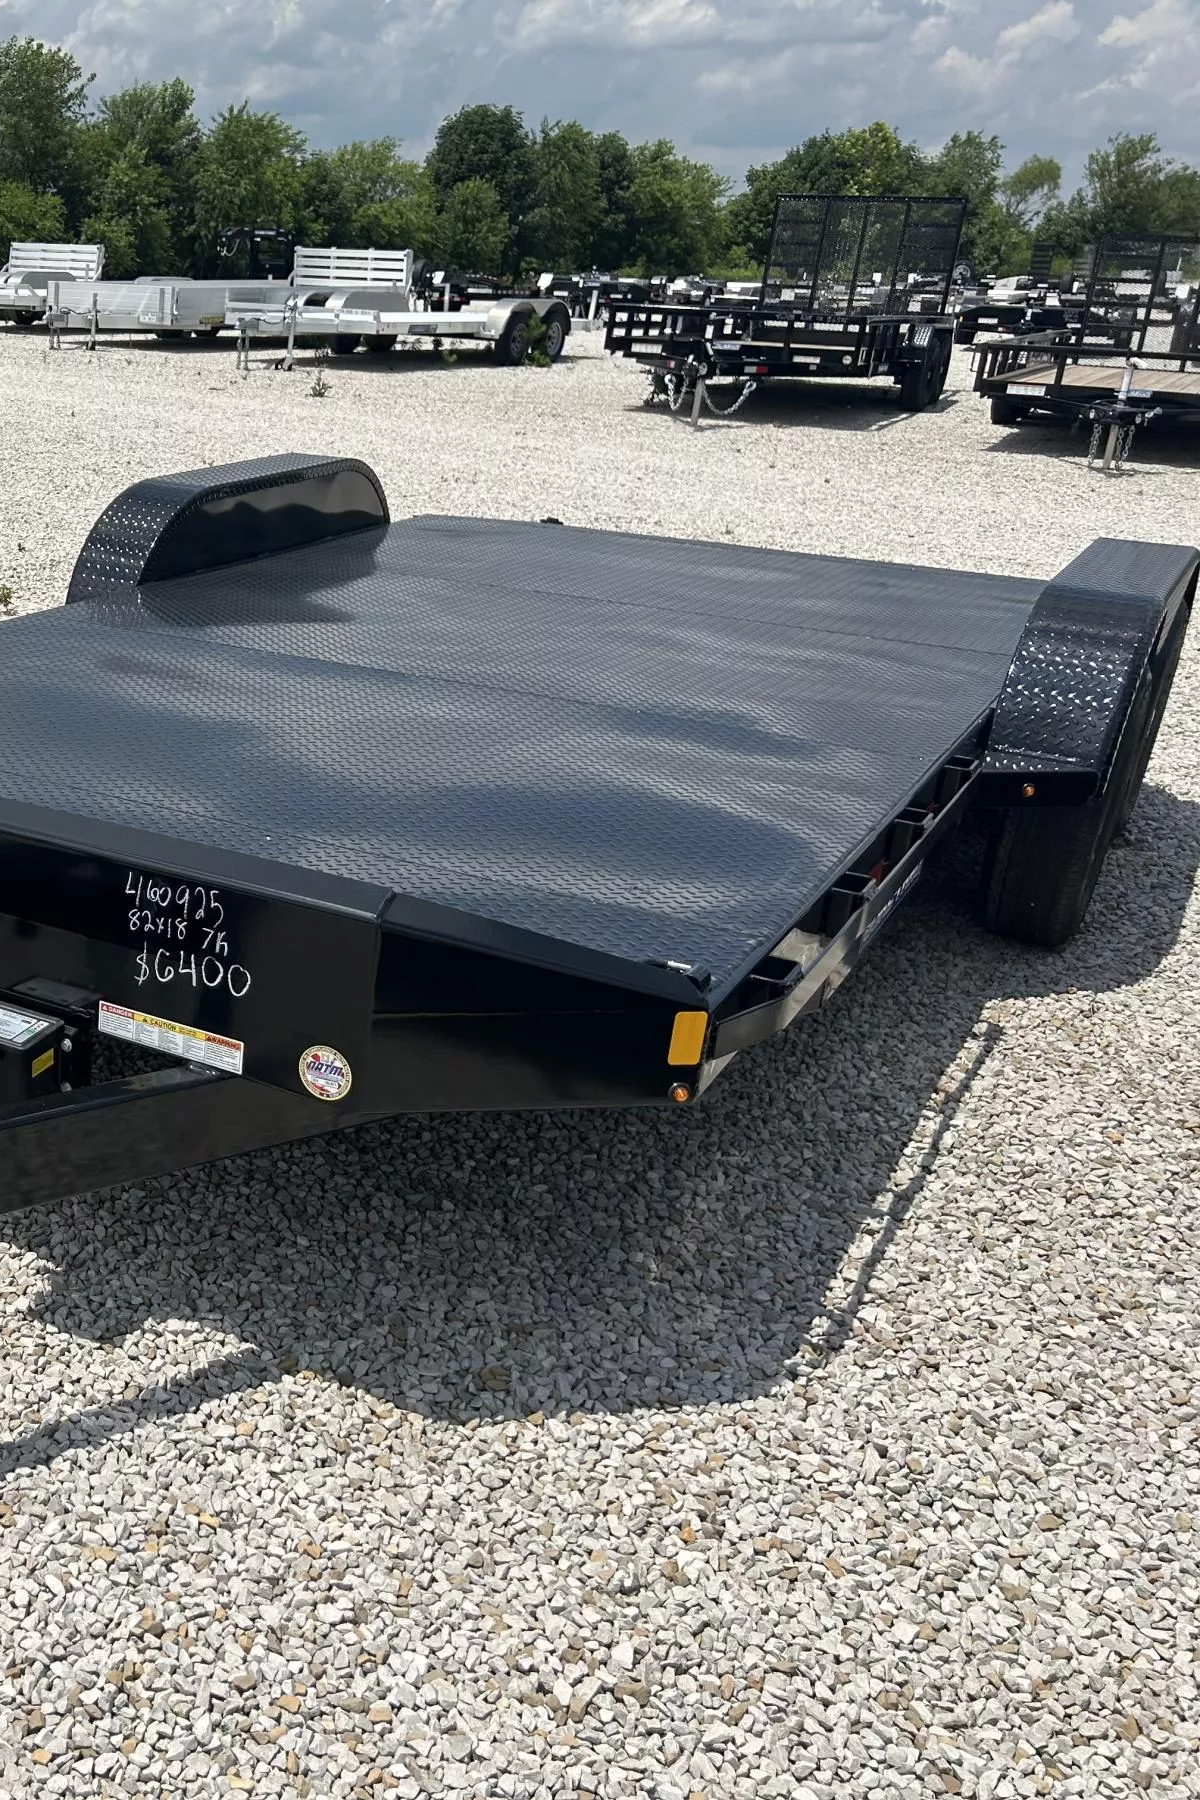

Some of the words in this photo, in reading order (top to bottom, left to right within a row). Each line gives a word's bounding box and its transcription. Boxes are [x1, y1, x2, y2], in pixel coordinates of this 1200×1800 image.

[125, 871, 224, 928] 460925
[134, 941, 252, 998] $6400
[108, 1006, 132, 1018] DANGER
[150, 1019, 177, 1032] CAUTION
[211, 1038, 240, 1050] WARNING
